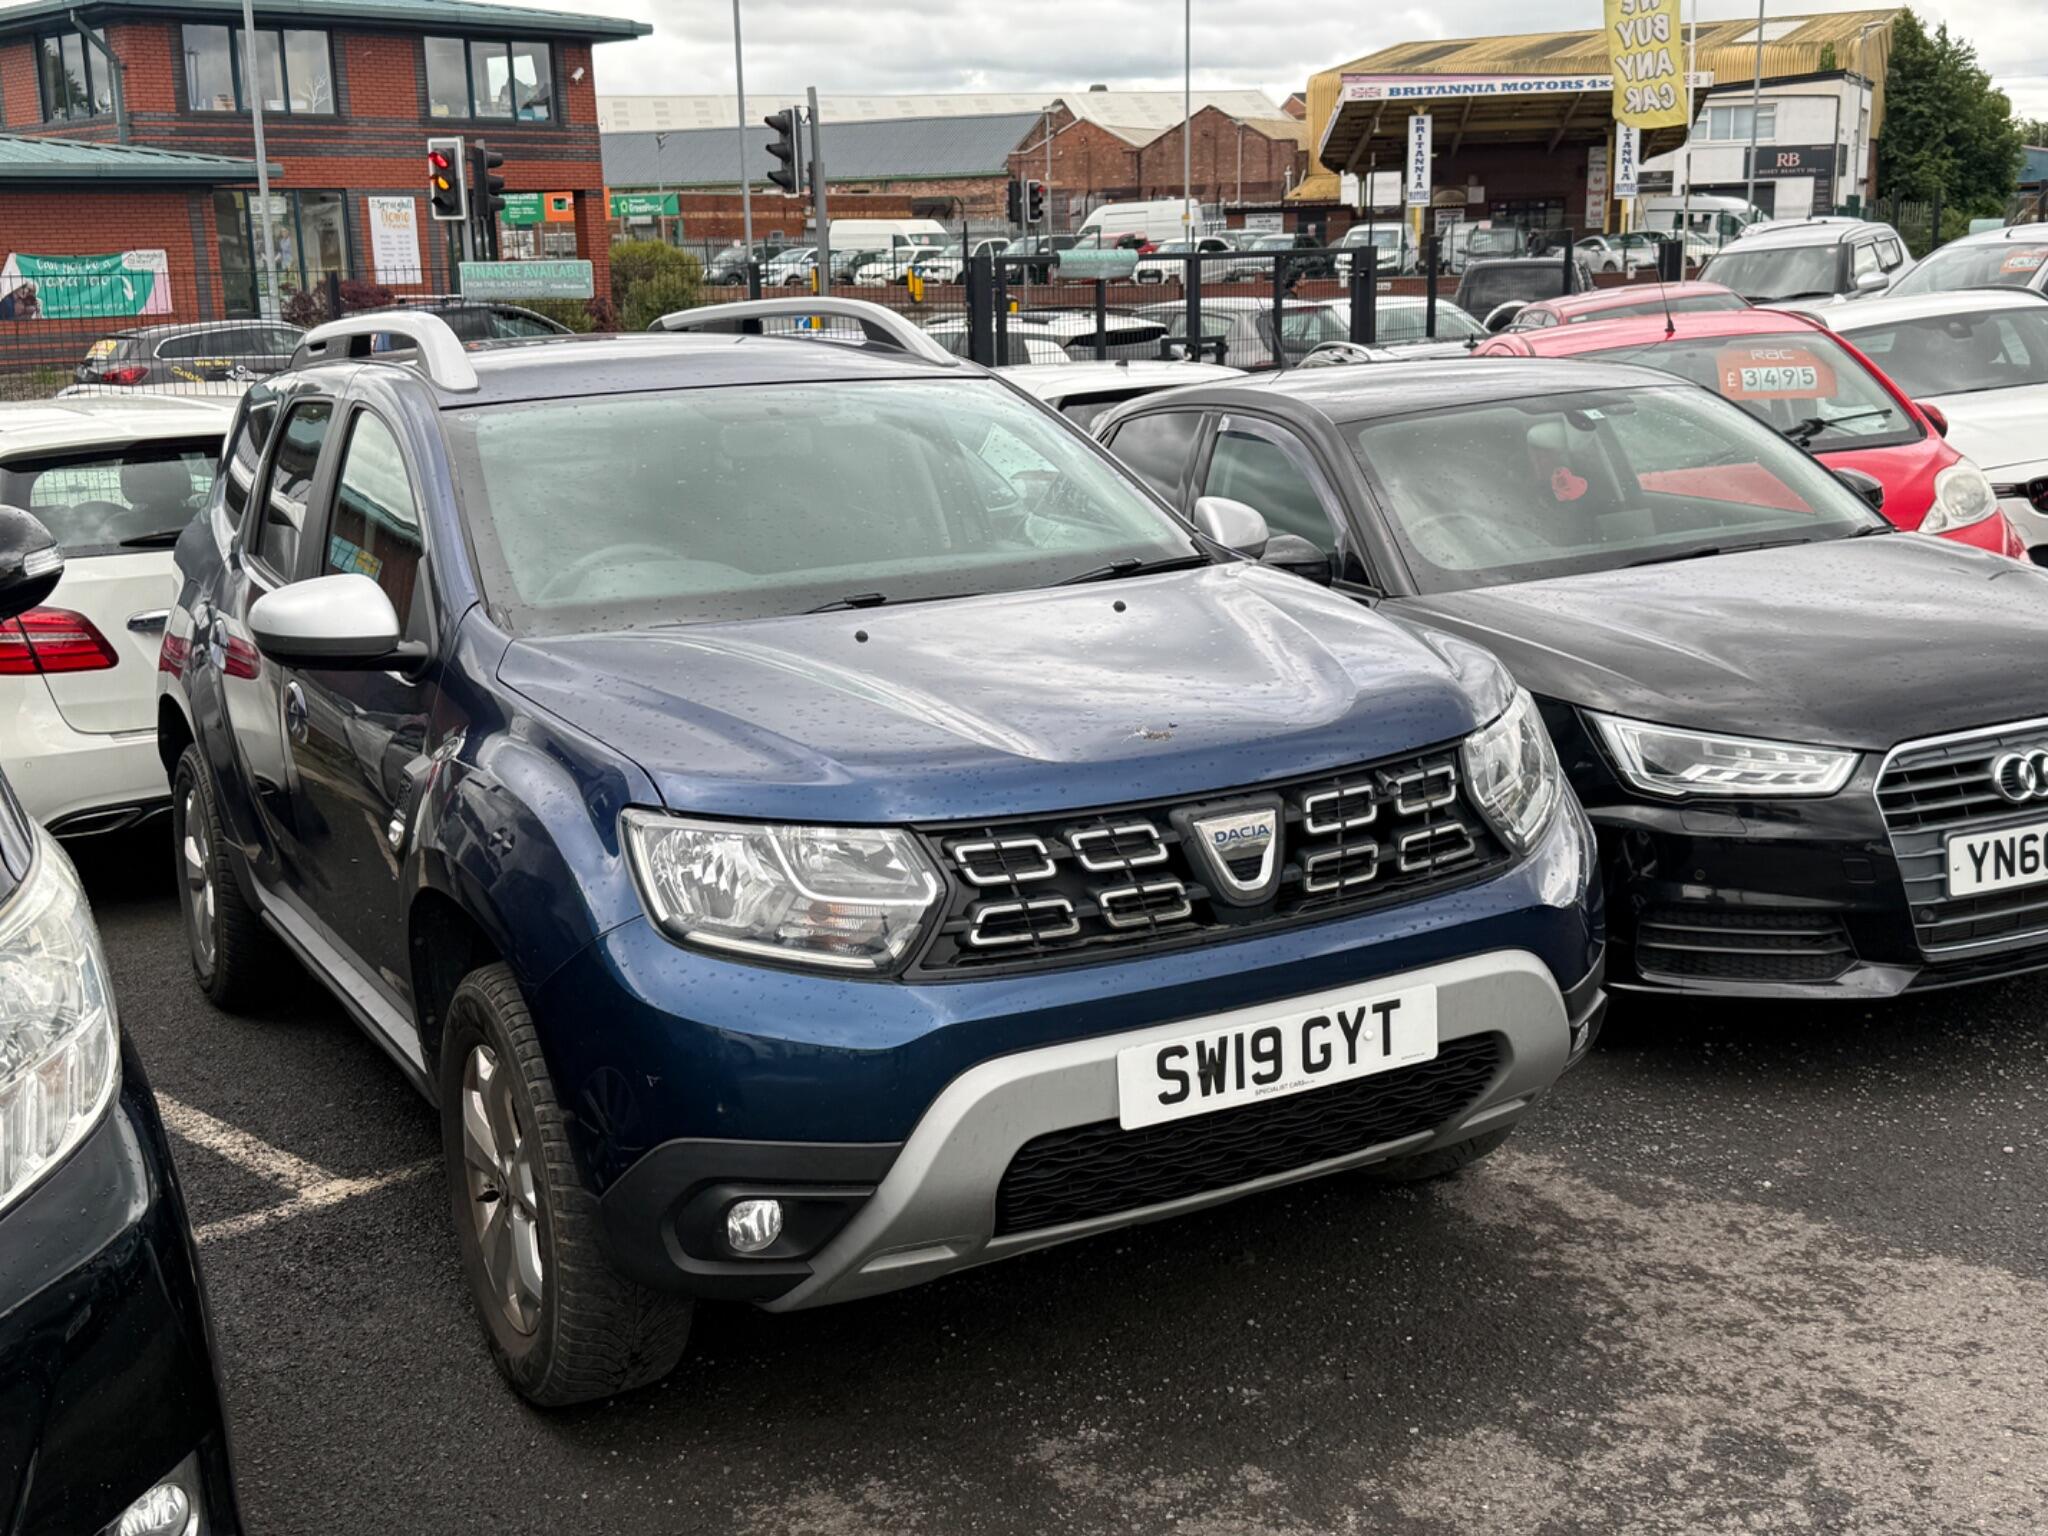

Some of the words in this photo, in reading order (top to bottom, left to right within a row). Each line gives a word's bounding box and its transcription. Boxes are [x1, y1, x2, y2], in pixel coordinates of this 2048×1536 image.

[1388, 83, 1496, 97] BRITANNIA
[1500, 79, 1584, 92] MOTORS
[1586, 78, 1615, 89] 4x
[1414, 117, 1426, 189] BRITANNIA
[1776, 151, 1801, 167] RB
[463, 265, 520, 280] FINANCE
[524, 263, 590, 279] AVAILABLE
[1744, 368, 1815, 387] 3495
[1214, 824, 1269, 843] DACIA
[1967, 832, 2048, 883] YN6
[1156, 1026, 1283, 1105] SW19
[1301, 998, 1402, 1075] GYT
[1255, 1083, 1288, 1096] SPECIALIST
